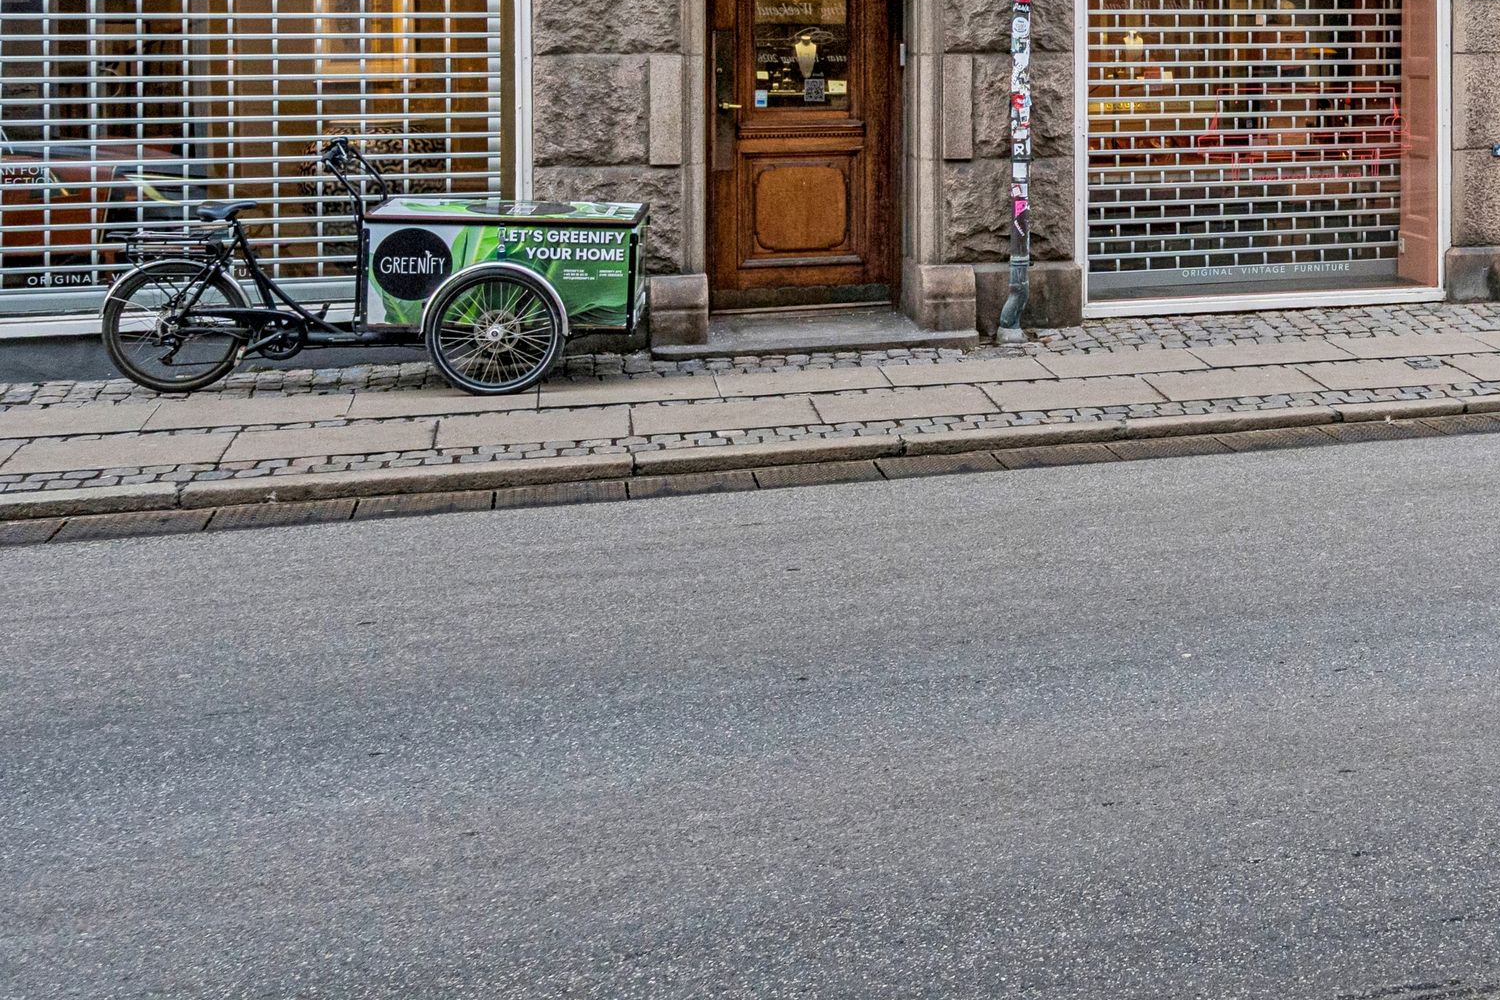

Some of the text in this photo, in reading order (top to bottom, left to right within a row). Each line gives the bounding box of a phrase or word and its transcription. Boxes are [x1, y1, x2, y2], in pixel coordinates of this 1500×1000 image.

[503, 230, 625, 244] LET'S GREENIFY
[526, 247, 624, 261] YOUR HOME
[380, 250, 446, 275] GREENIFY
[1182, 263, 1350, 278] ORIGINAL VINTAGE FURNITURE
